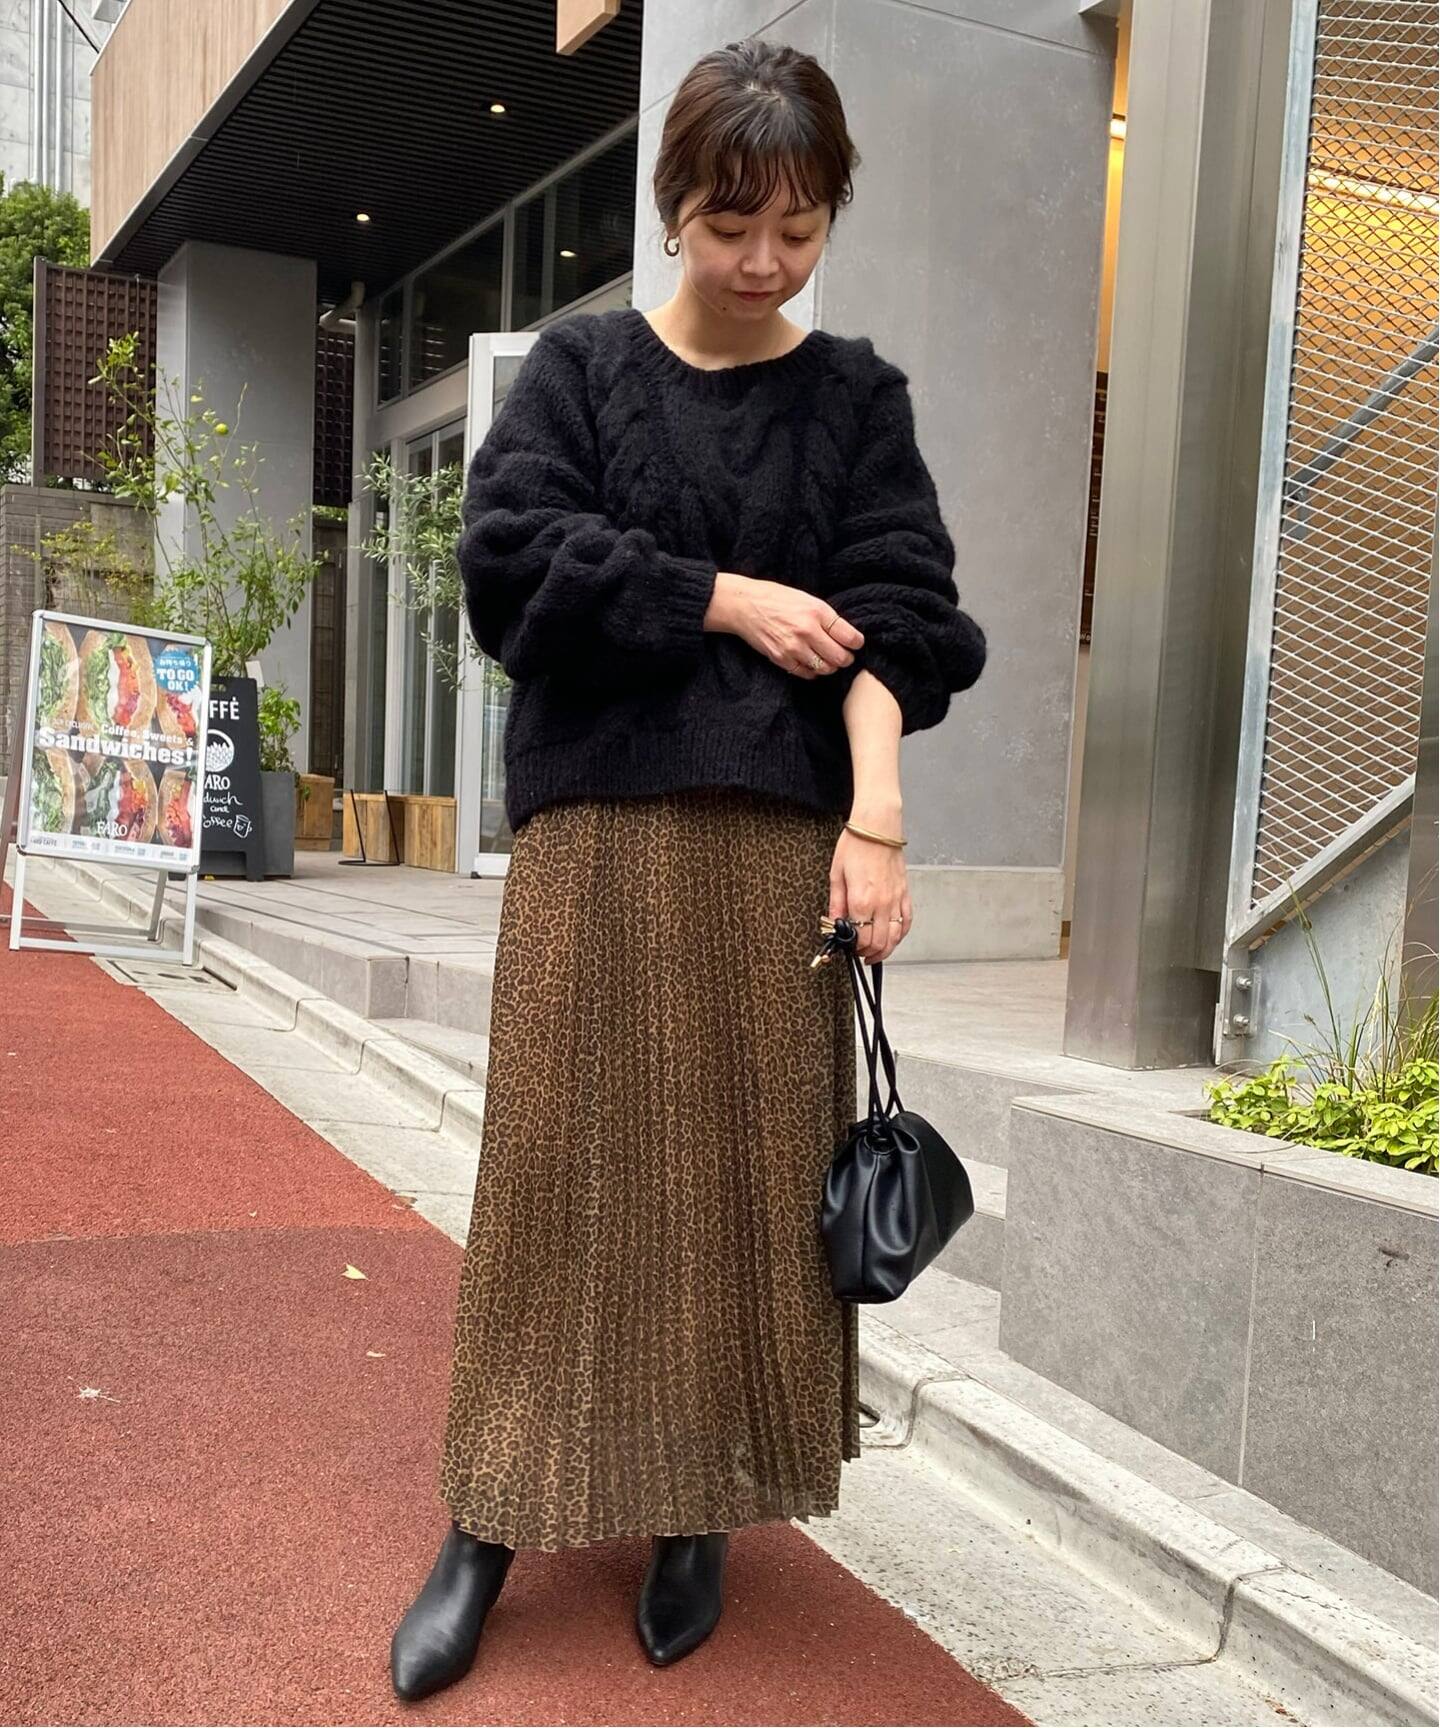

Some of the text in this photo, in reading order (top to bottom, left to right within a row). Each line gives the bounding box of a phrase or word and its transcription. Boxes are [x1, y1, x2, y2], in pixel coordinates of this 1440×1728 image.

[156, 668, 196, 682] TO GO
[167, 680, 189, 692] OK!
[38, 726, 194, 766] Sandwiches!
[204, 773, 231, 791] ARO
[203, 791, 243, 806] dwich
[96, 820, 128, 838] FARO
[202, 814, 233, 829] offee
